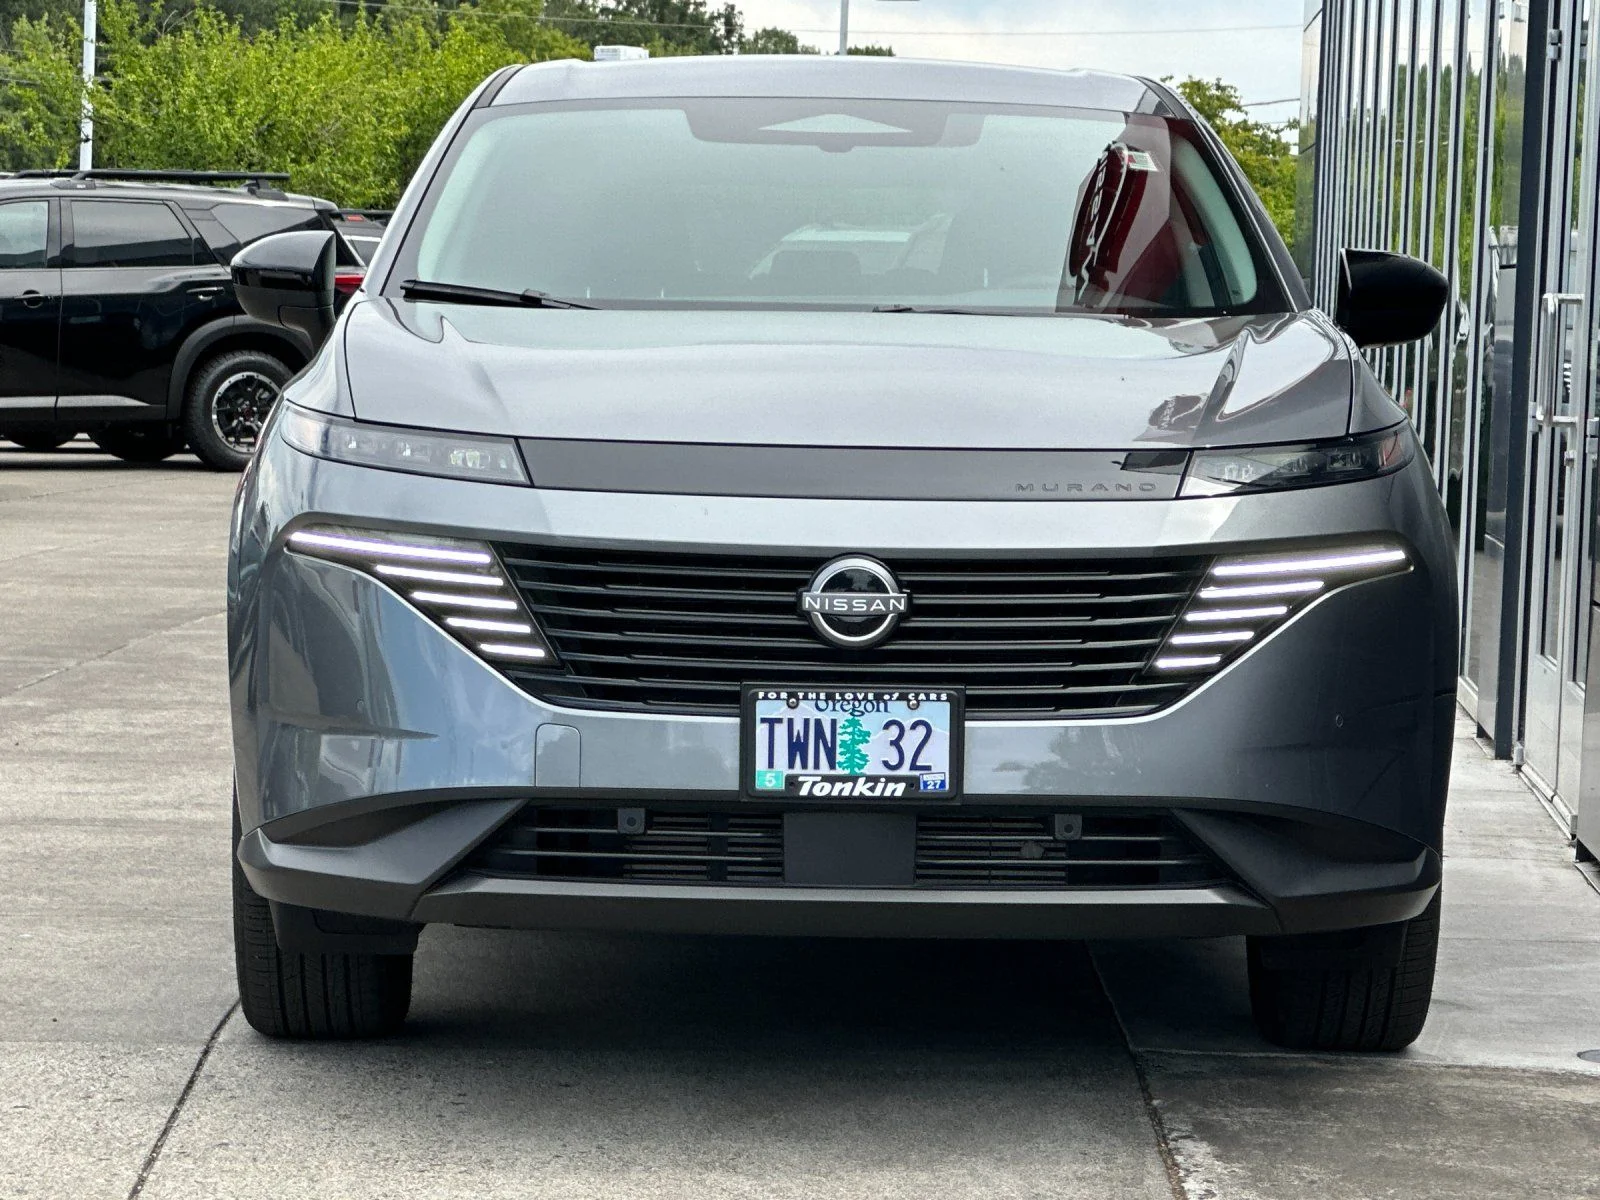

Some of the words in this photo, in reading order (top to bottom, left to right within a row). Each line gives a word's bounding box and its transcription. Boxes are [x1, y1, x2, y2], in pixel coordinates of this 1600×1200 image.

[1014, 483, 1157, 492] MURANO
[805, 596, 905, 612] NISSAN
[758, 691, 788, 700] FOR
[797, 692, 826, 700] THE
[835, 692, 875, 701] LOVE
[883, 692, 900, 701] of
[907, 693, 948, 701] CARS
[814, 699, 891, 717] Oregon
[760, 717, 838, 770] TWN
[882, 719, 933, 771] 32
[765, 772, 777, 787] 5
[797, 776, 907, 797] Tonkin
[927, 780, 942, 790] 27
